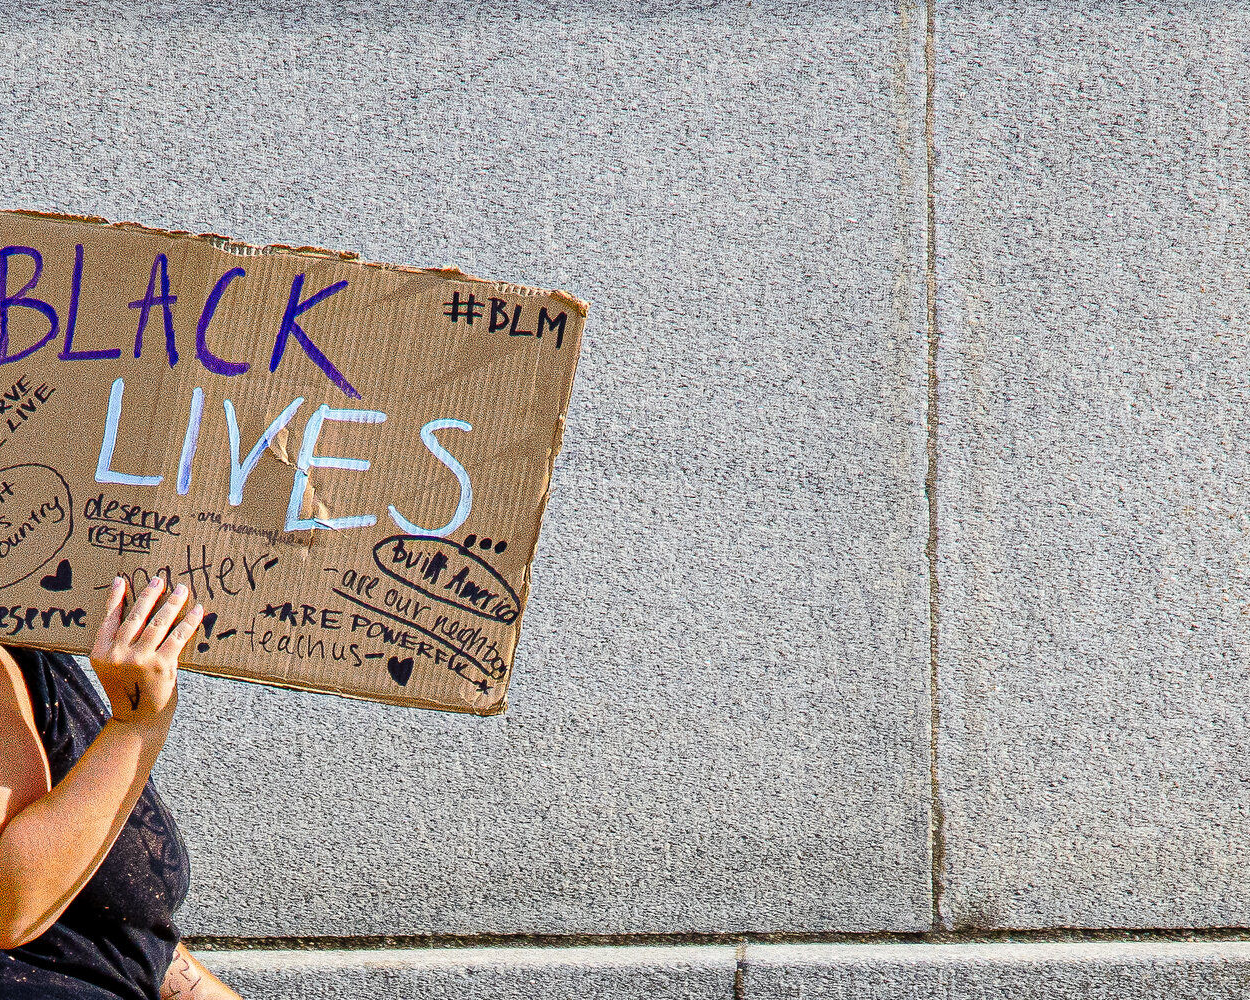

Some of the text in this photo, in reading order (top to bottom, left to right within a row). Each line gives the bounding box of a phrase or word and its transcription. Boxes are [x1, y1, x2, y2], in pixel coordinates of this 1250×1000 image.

[443, 291, 568, 350] #BLM
[6, 382, 57, 434] LIVE
[95, 377, 473, 537] LIVES
[84, 493, 180, 536] deserve
[391, 538, 448, 585] built
[385, 588, 431, 621] our
